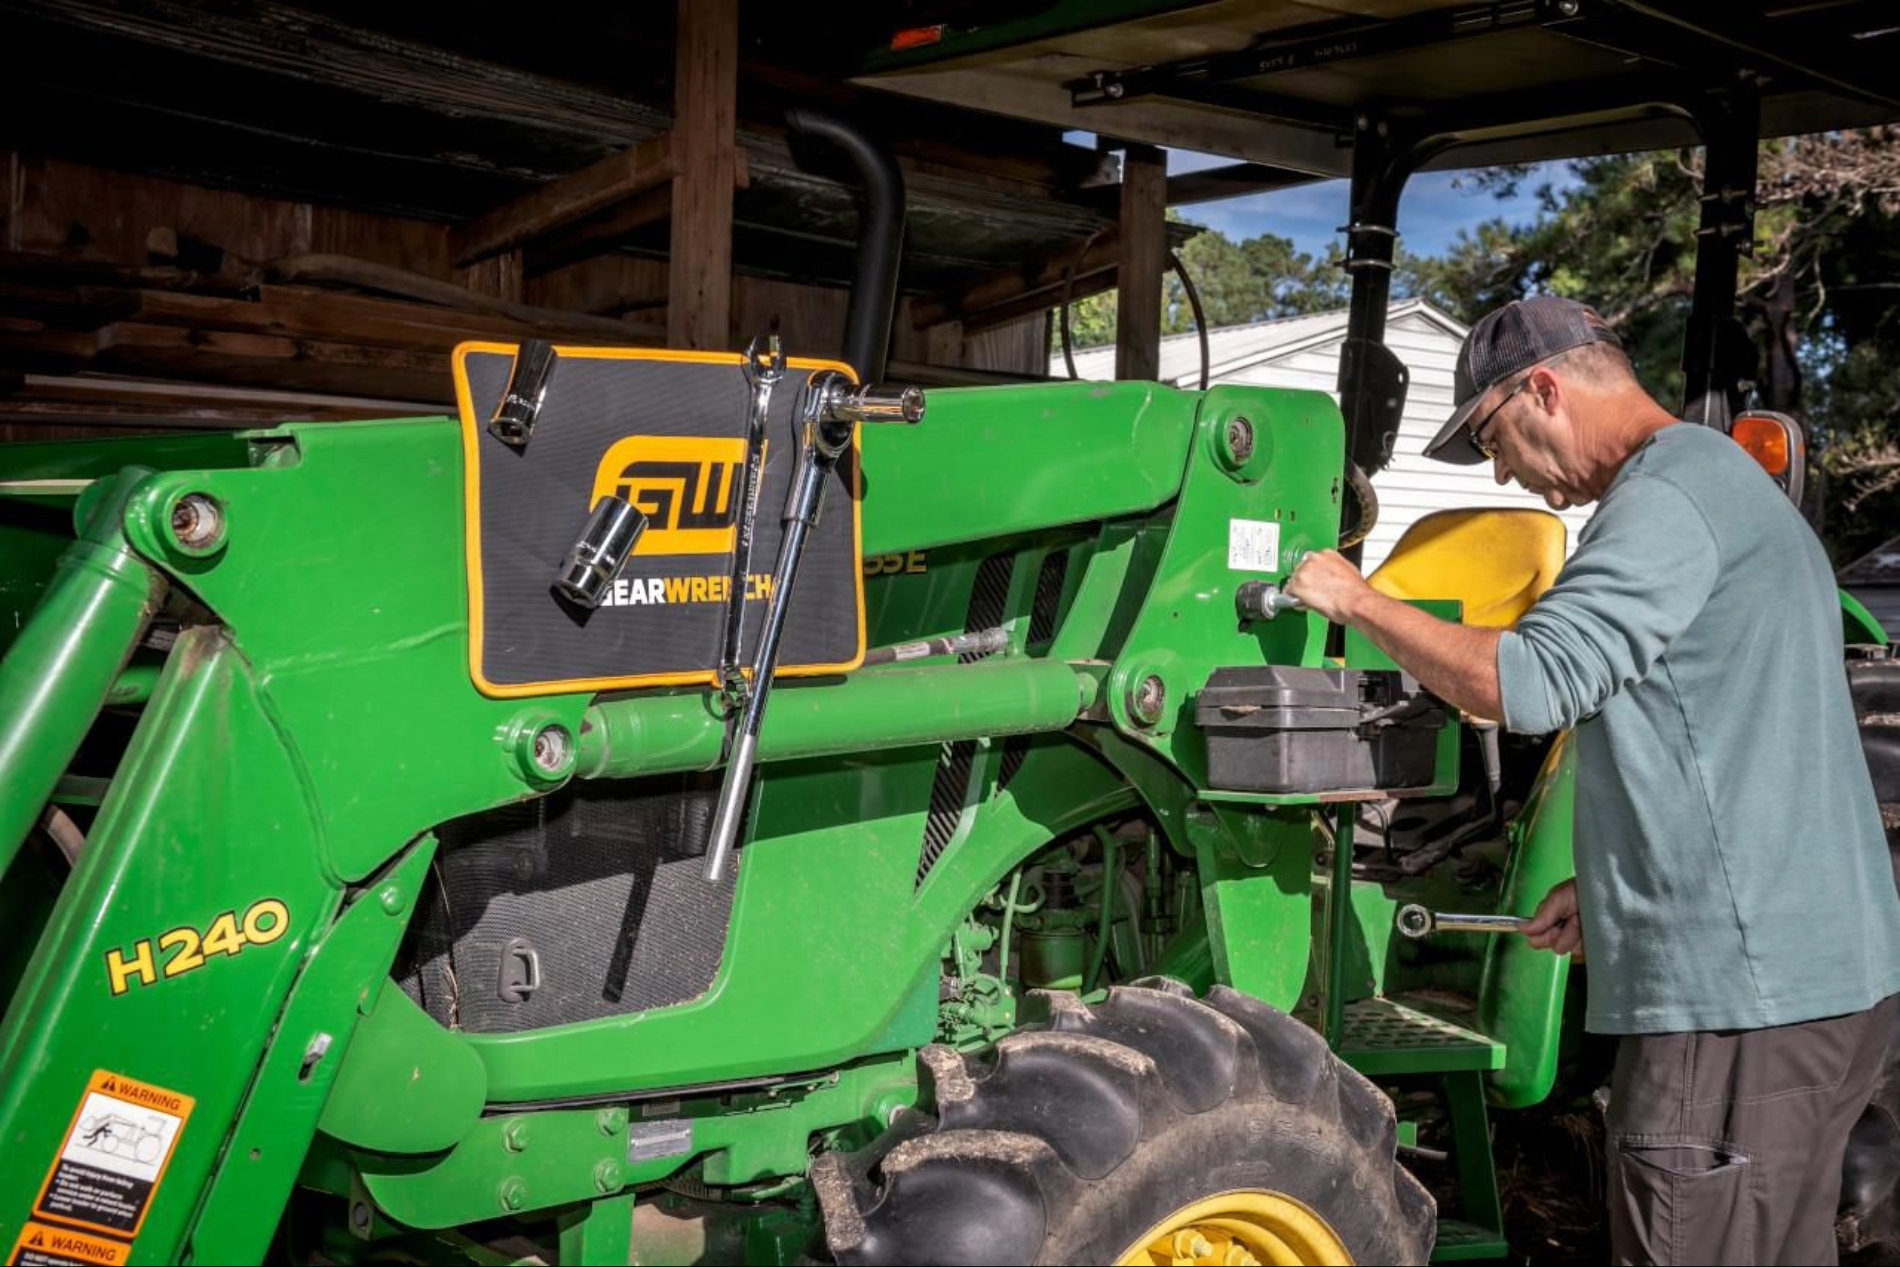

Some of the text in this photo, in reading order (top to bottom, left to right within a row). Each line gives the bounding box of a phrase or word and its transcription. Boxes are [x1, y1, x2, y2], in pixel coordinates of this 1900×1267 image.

[105, 898, 290, 996] H240
[119, 1083, 181, 1111] WARNING
[51, 1235, 116, 1262] WARNING
